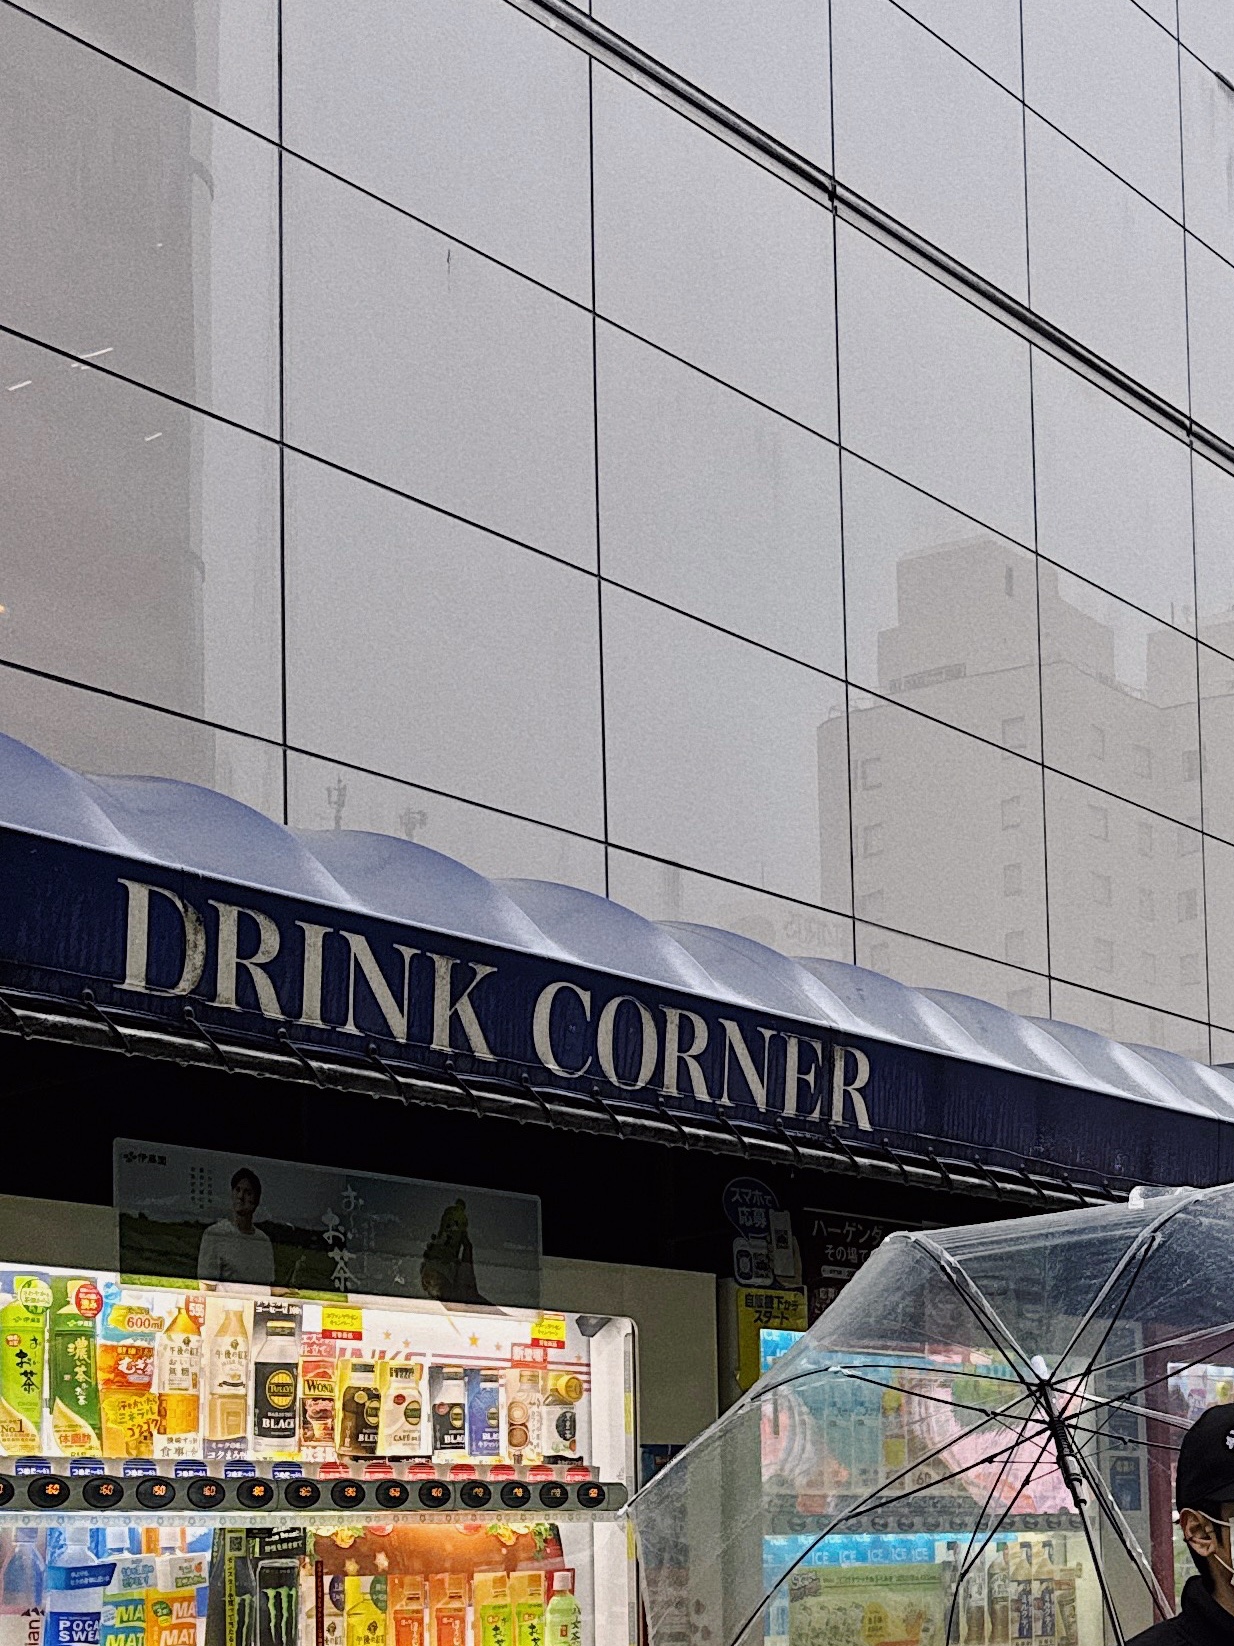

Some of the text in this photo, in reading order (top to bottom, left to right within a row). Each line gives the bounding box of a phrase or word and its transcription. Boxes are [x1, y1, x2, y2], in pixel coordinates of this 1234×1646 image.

[115, 877, 874, 1132] DRINK CORNER
[730, 1187, 773, 1207] スマホで
[127, 1316, 164, 1331] 600ml
[753, 1310, 790, 1325] スタート
